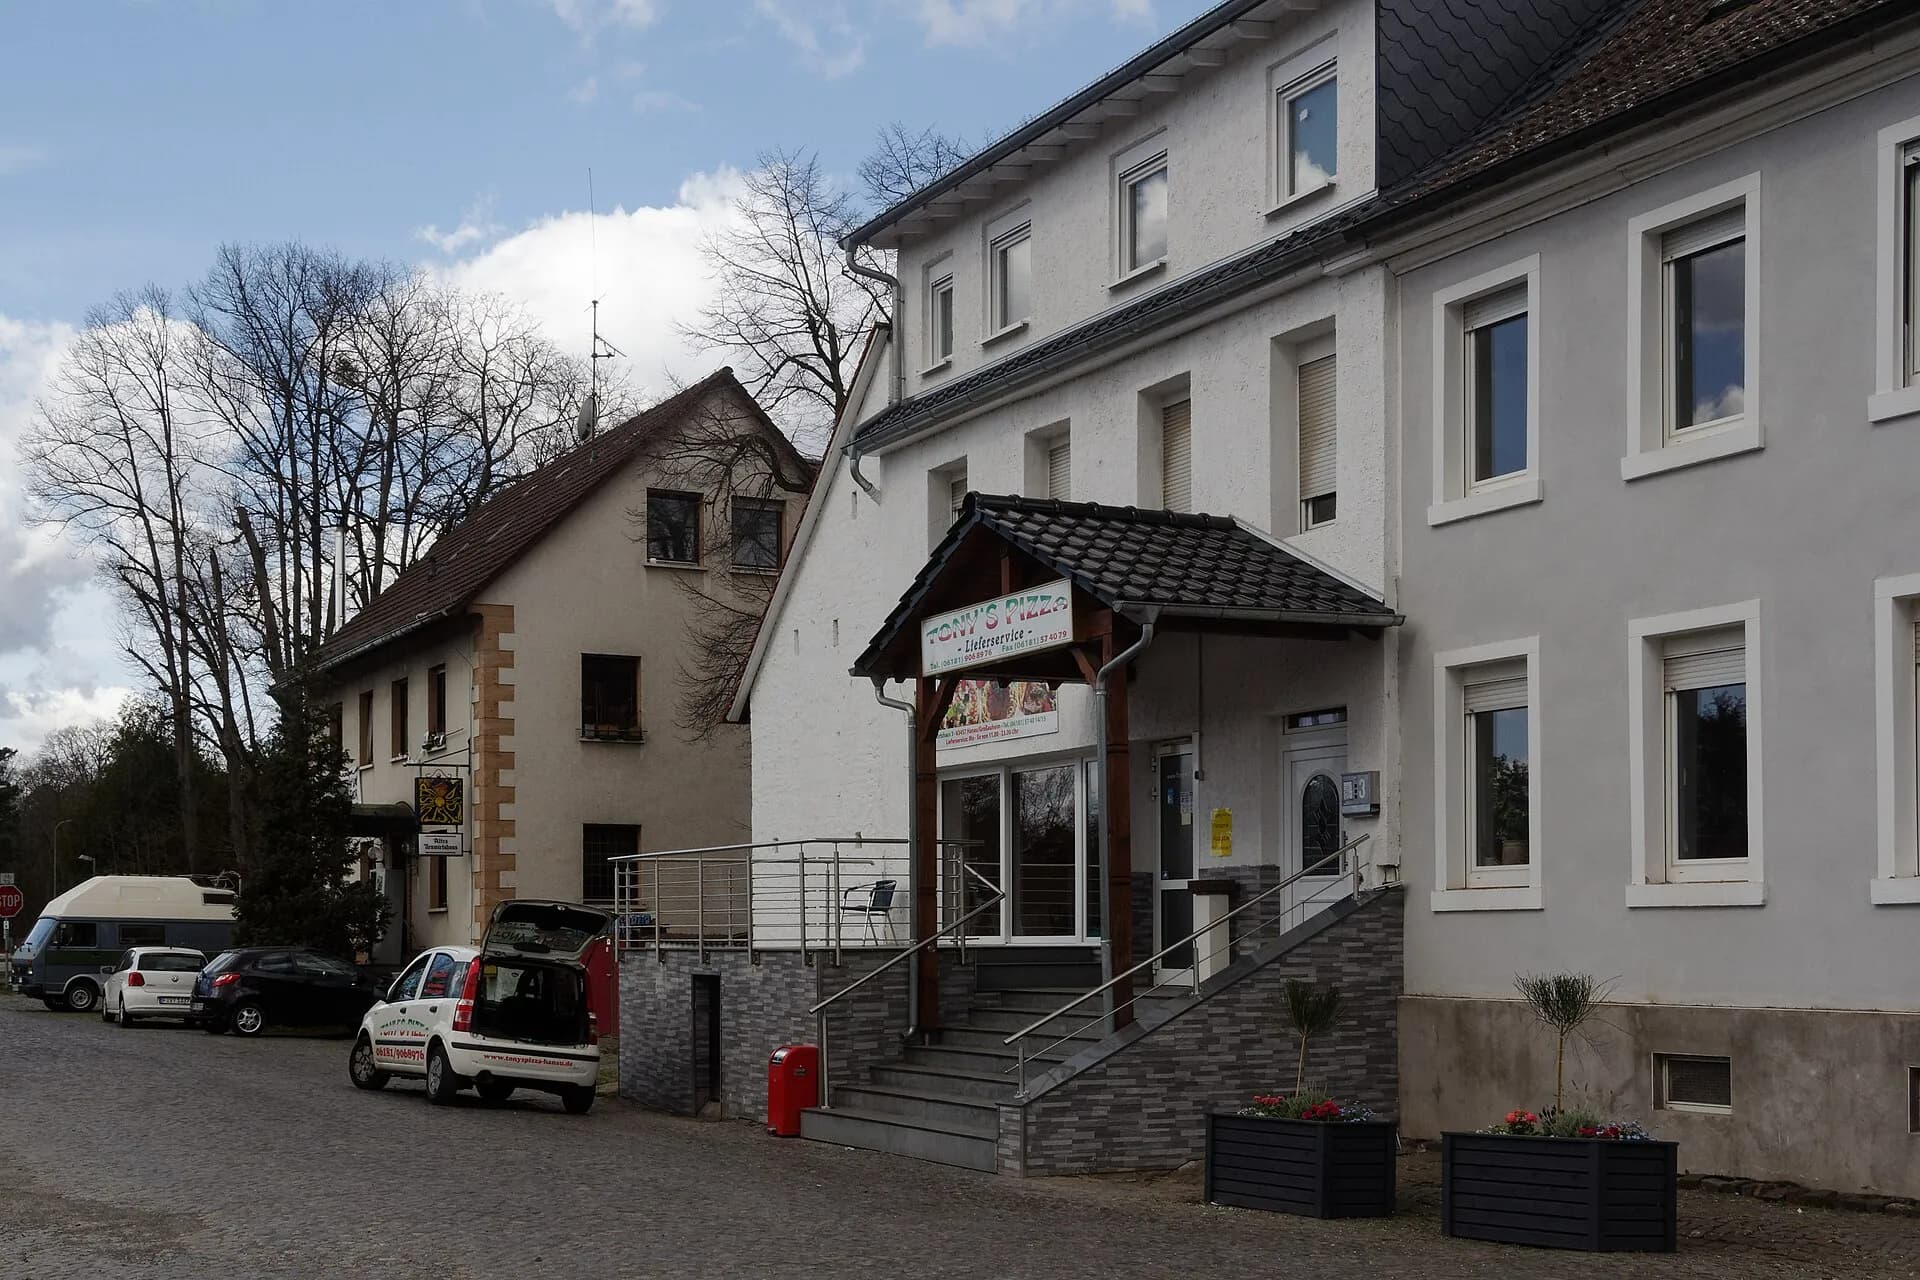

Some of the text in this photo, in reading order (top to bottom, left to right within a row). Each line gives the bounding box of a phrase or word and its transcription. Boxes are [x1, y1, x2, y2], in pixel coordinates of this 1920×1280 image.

[926, 594, 1068, 645] TONY'S PIZZA
[965, 628, 1025, 654] Lieferservice
[930, 660, 941, 670] Tel.
[1001, 643, 1014, 653] Fax
[1359, 778, 1366, 799] 3
[375, 1047, 425, 1061] 06181/9068976
